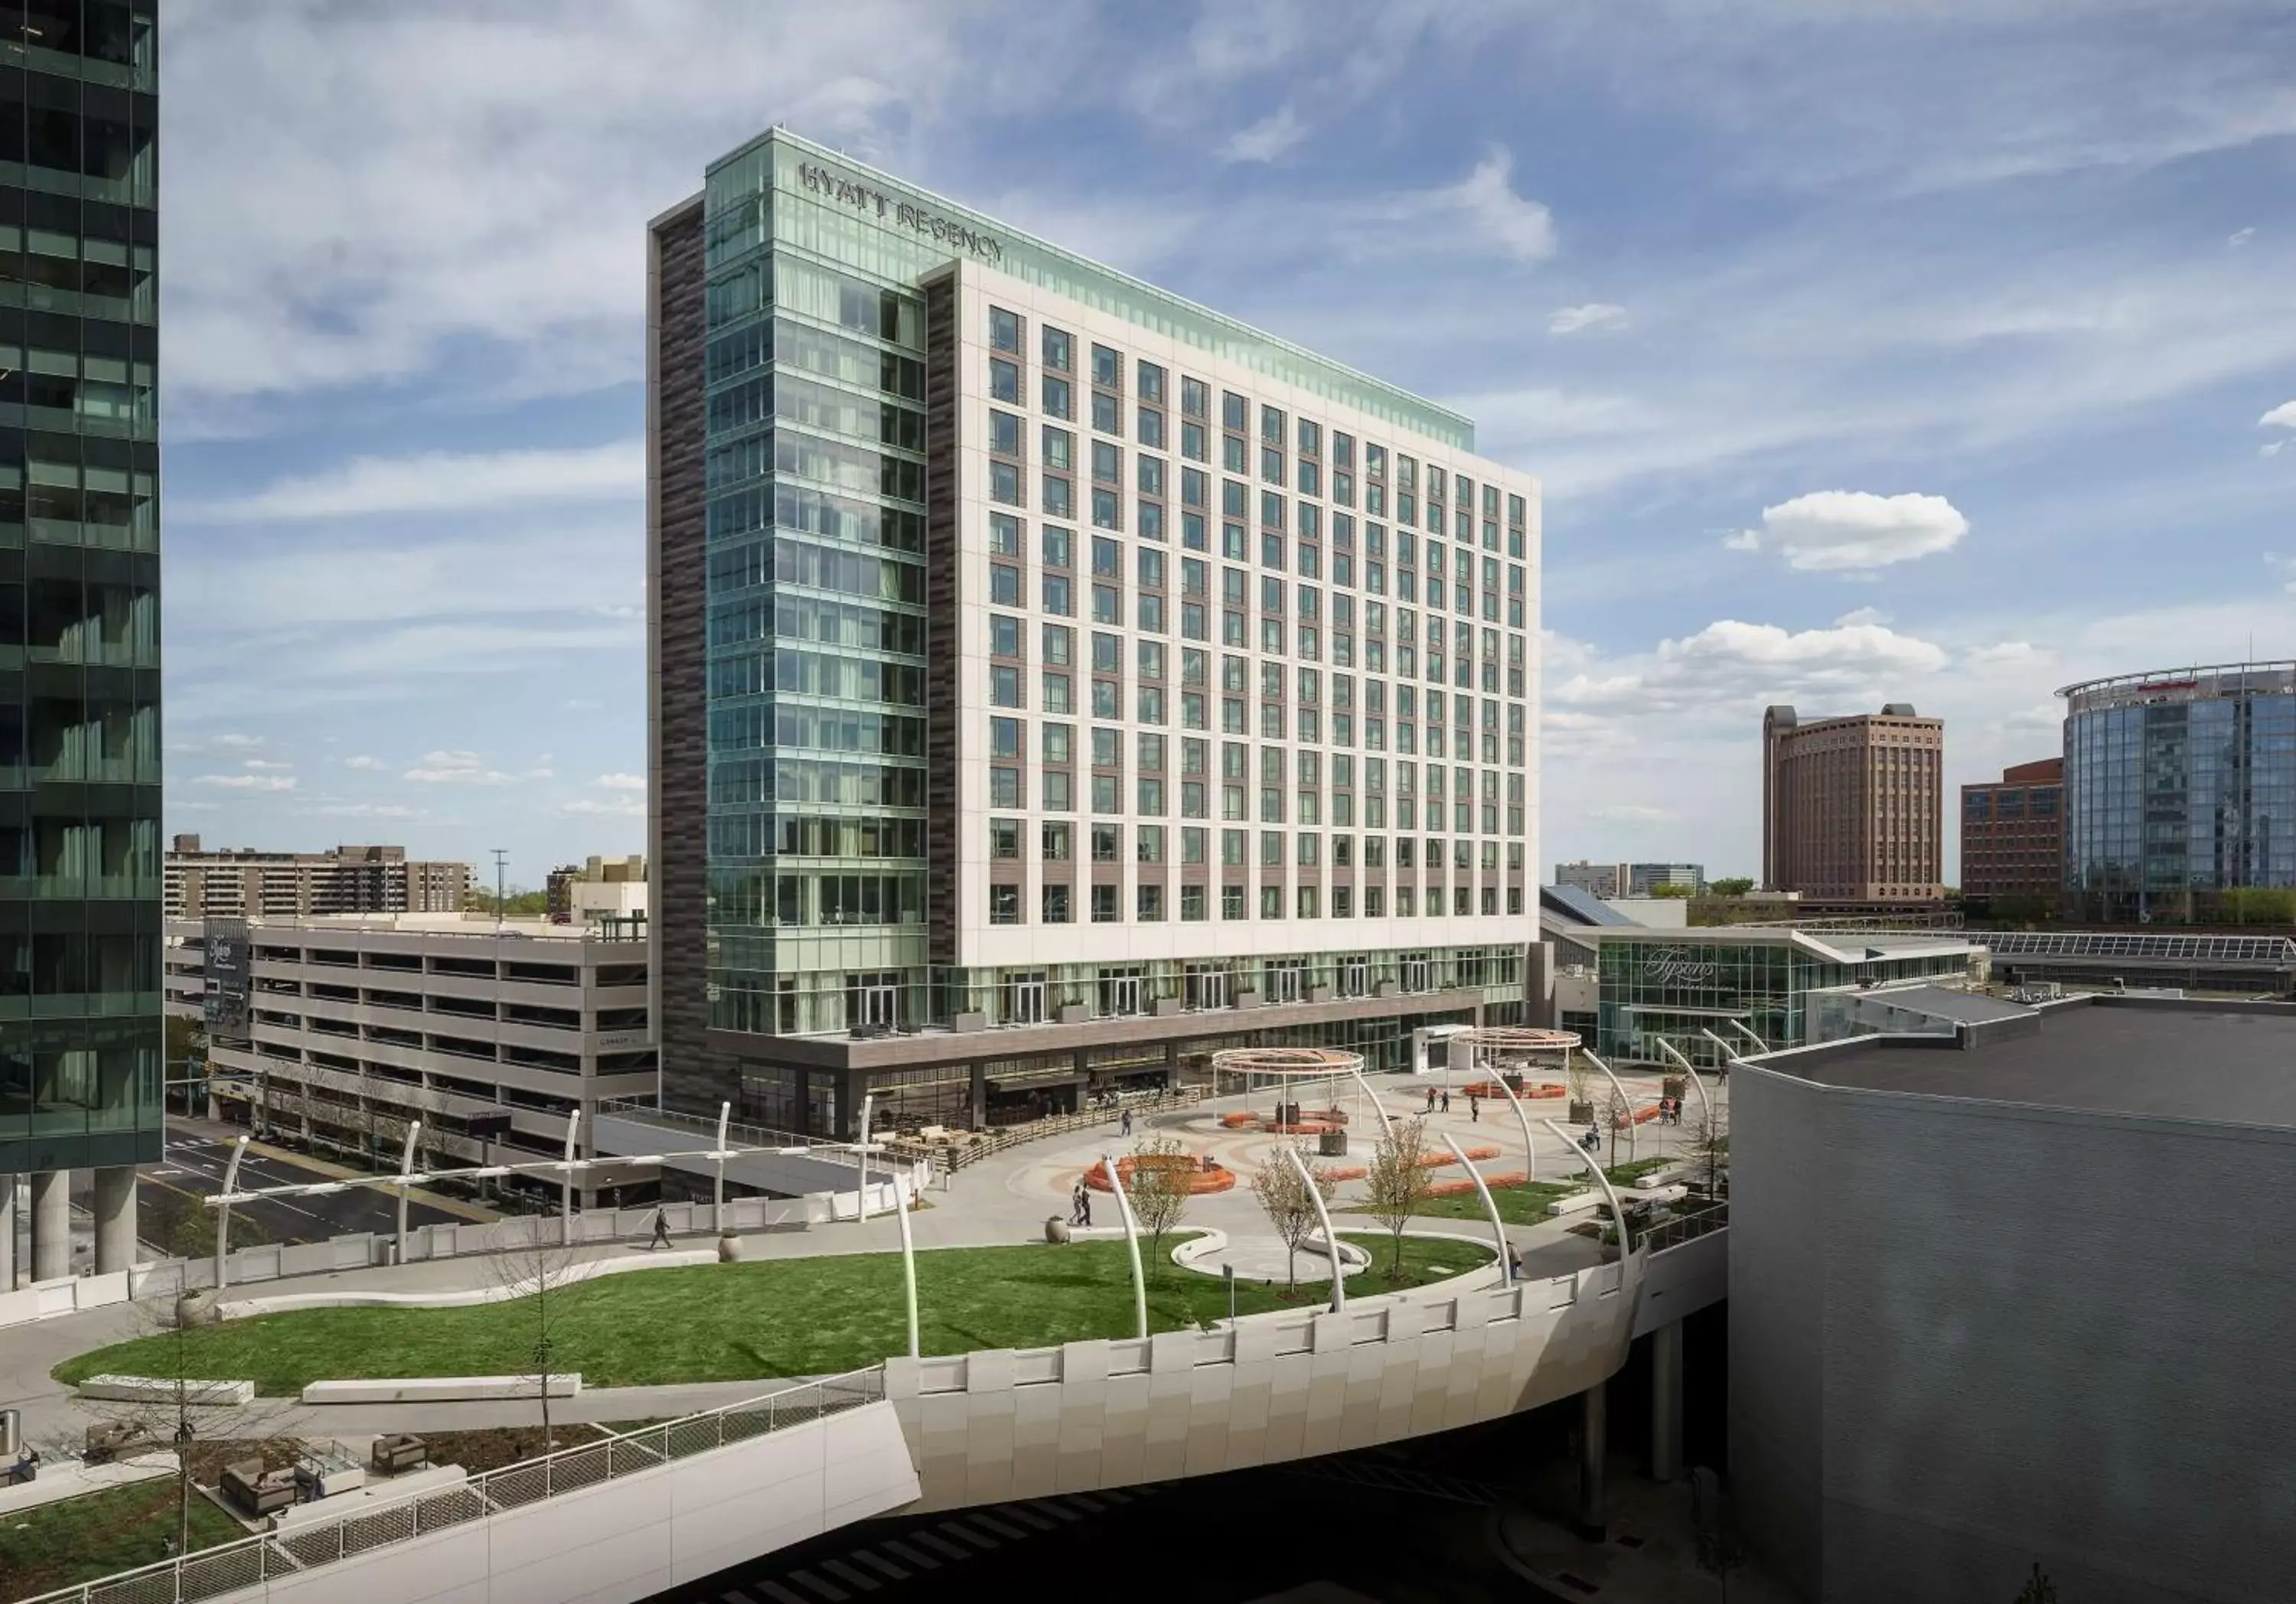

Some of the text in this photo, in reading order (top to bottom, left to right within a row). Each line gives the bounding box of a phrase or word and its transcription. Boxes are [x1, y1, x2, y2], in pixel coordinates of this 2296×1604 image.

[799, 161, 1003, 262] HYATT REGENCY
[1644, 947, 1714, 984] Tysons
